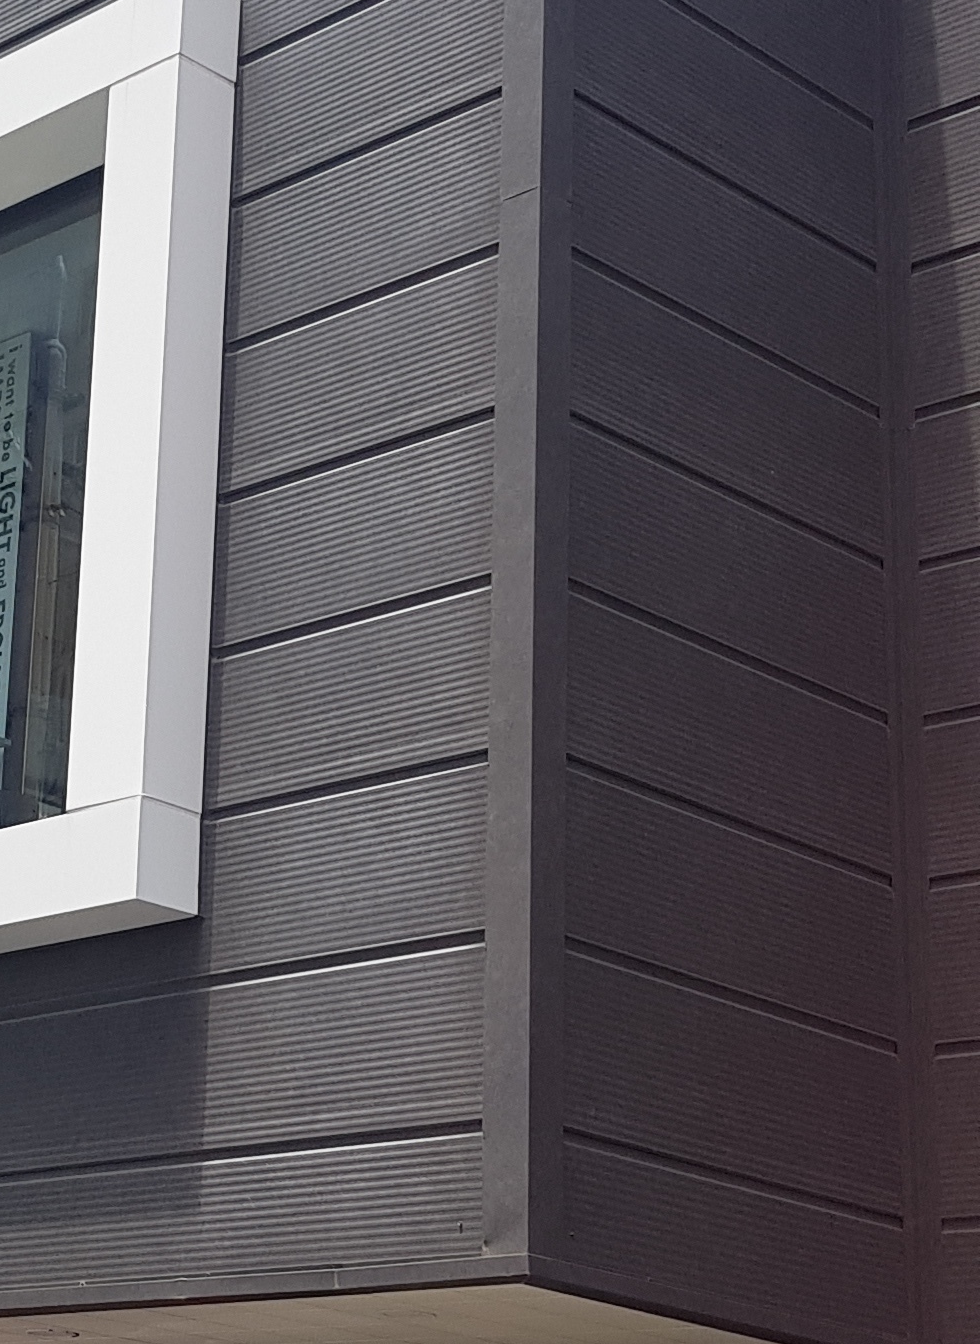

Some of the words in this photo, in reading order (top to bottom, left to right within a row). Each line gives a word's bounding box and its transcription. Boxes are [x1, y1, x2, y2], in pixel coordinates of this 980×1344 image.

[4, 358, 16, 407] want
[3, 412, 13, 433] to
[1, 438, 14, 463] be
